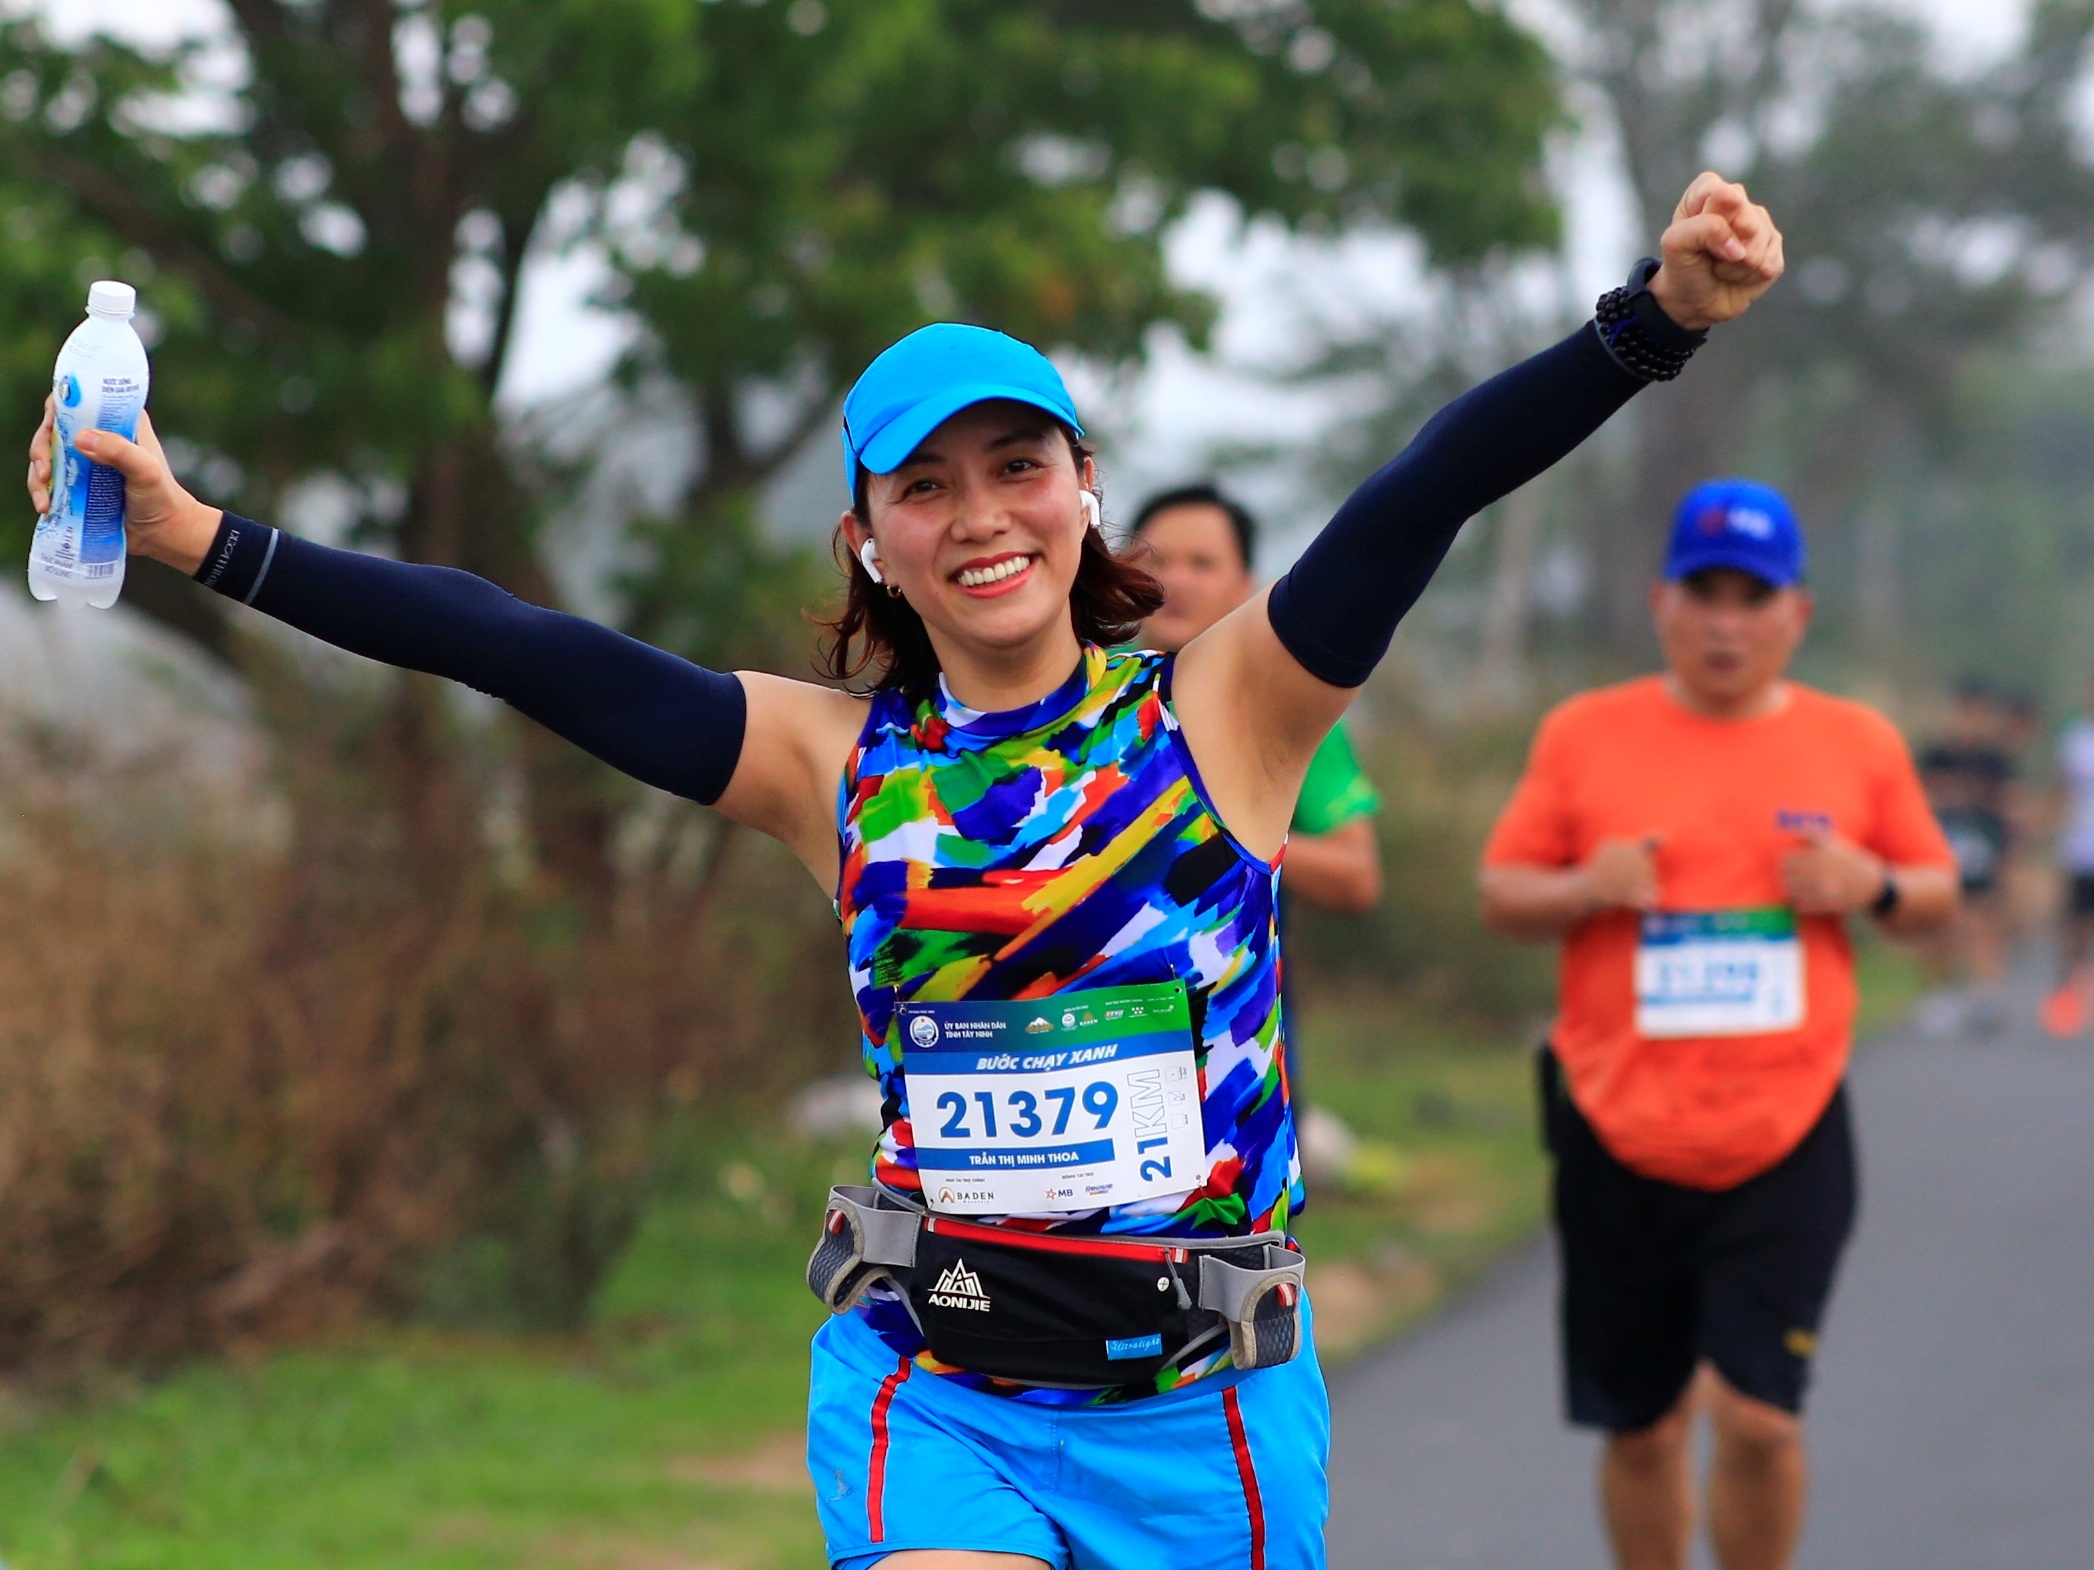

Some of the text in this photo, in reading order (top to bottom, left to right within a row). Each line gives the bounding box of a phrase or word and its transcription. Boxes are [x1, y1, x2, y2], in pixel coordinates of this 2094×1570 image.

[955, 1022, 969, 1030] BAN
[962, 1029, 974, 1038] TÂY
[974, 1030, 993, 1038] NINH
[976, 1044, 1118, 1071] BƯỚC CHẠY XANH
[936, 1081, 1119, 1138] 21379
[969, 1151, 1079, 1167] TRẦN THỊ MINH THOA
[957, 1191, 994, 1200] BADEN
[1058, 1188, 1073, 1197] MB
[928, 1294, 991, 1312] AONIJIE
[1109, 1337, 1160, 1351] Ultralight
